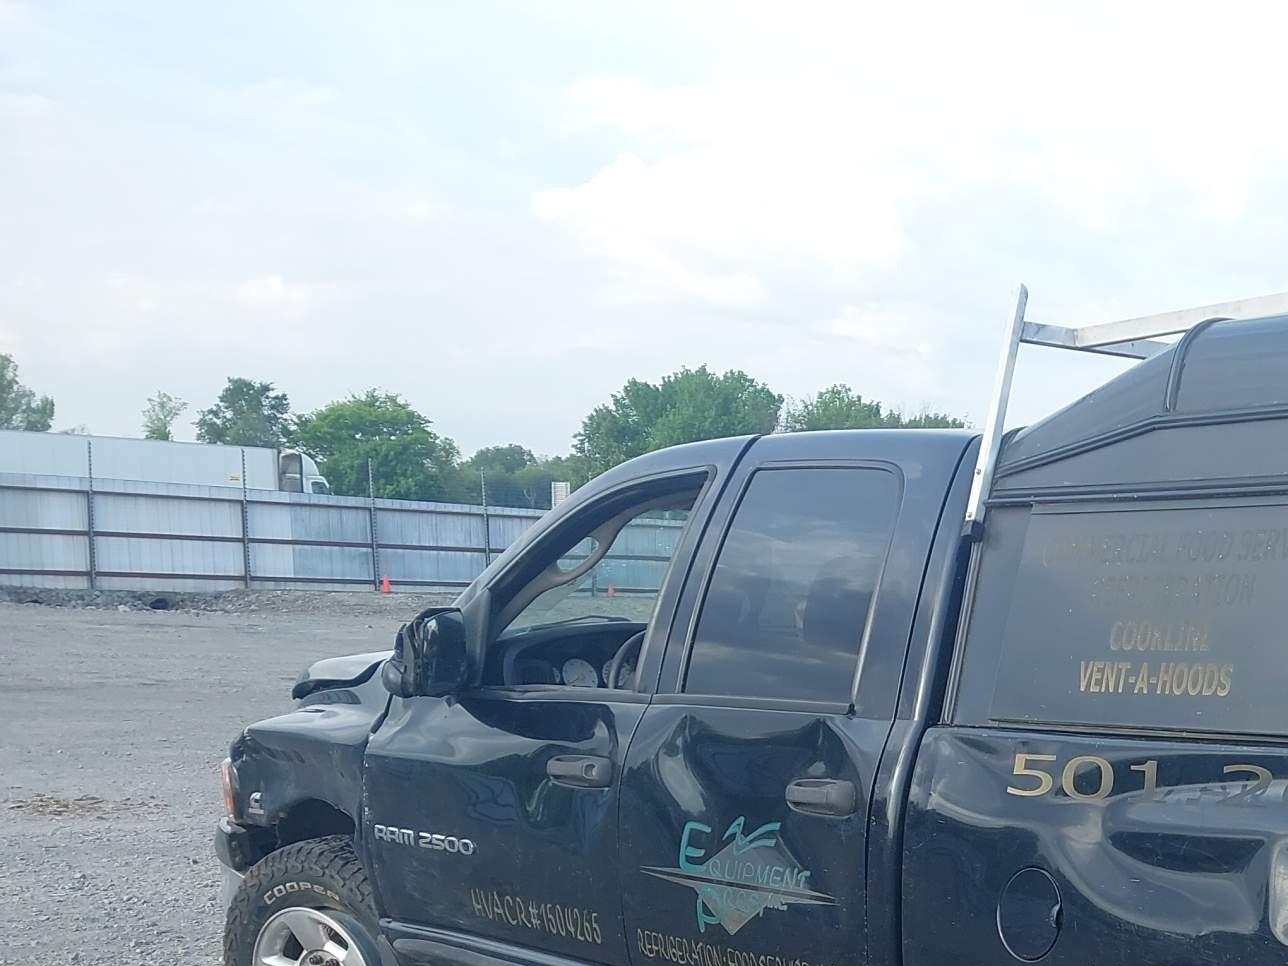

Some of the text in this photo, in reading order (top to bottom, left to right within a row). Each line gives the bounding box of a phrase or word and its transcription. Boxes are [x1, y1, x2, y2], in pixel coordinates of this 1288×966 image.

[1079, 660, 1234, 697] VENT-A-HOODS
[374, 823, 474, 856] RAM 2500
[679, 821, 811, 889] EQUIPMENT
[263, 880, 341, 906] COOPER
